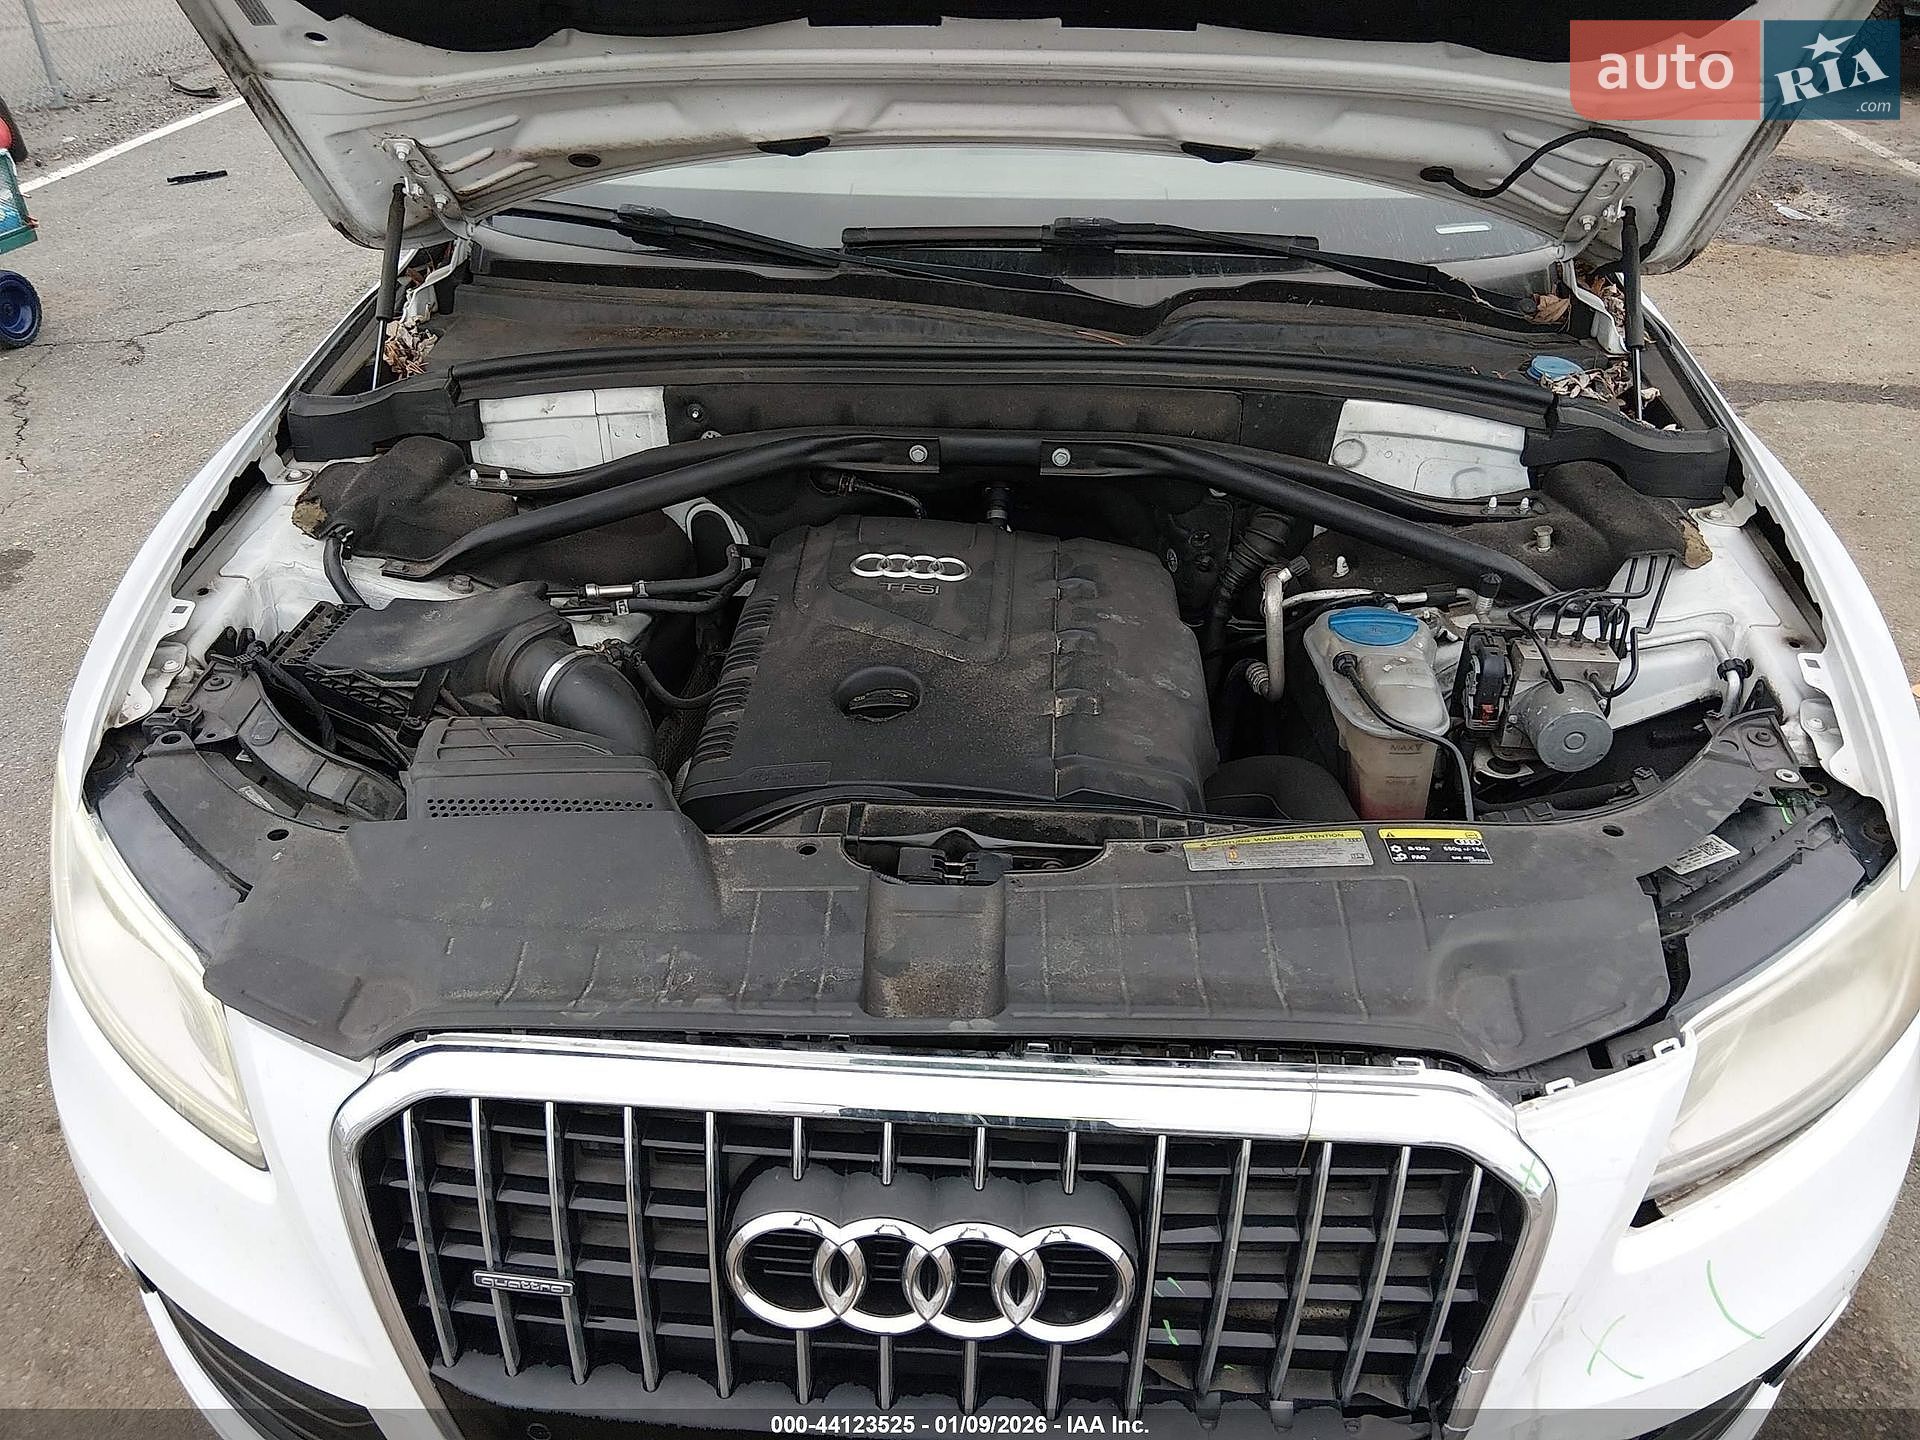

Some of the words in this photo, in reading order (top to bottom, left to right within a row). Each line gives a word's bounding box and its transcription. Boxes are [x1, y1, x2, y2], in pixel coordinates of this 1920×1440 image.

[879, 582, 941, 595] TFSI
[1298, 832, 1345, 840] ATTENTION
[481, 1277, 564, 1292] quattro
